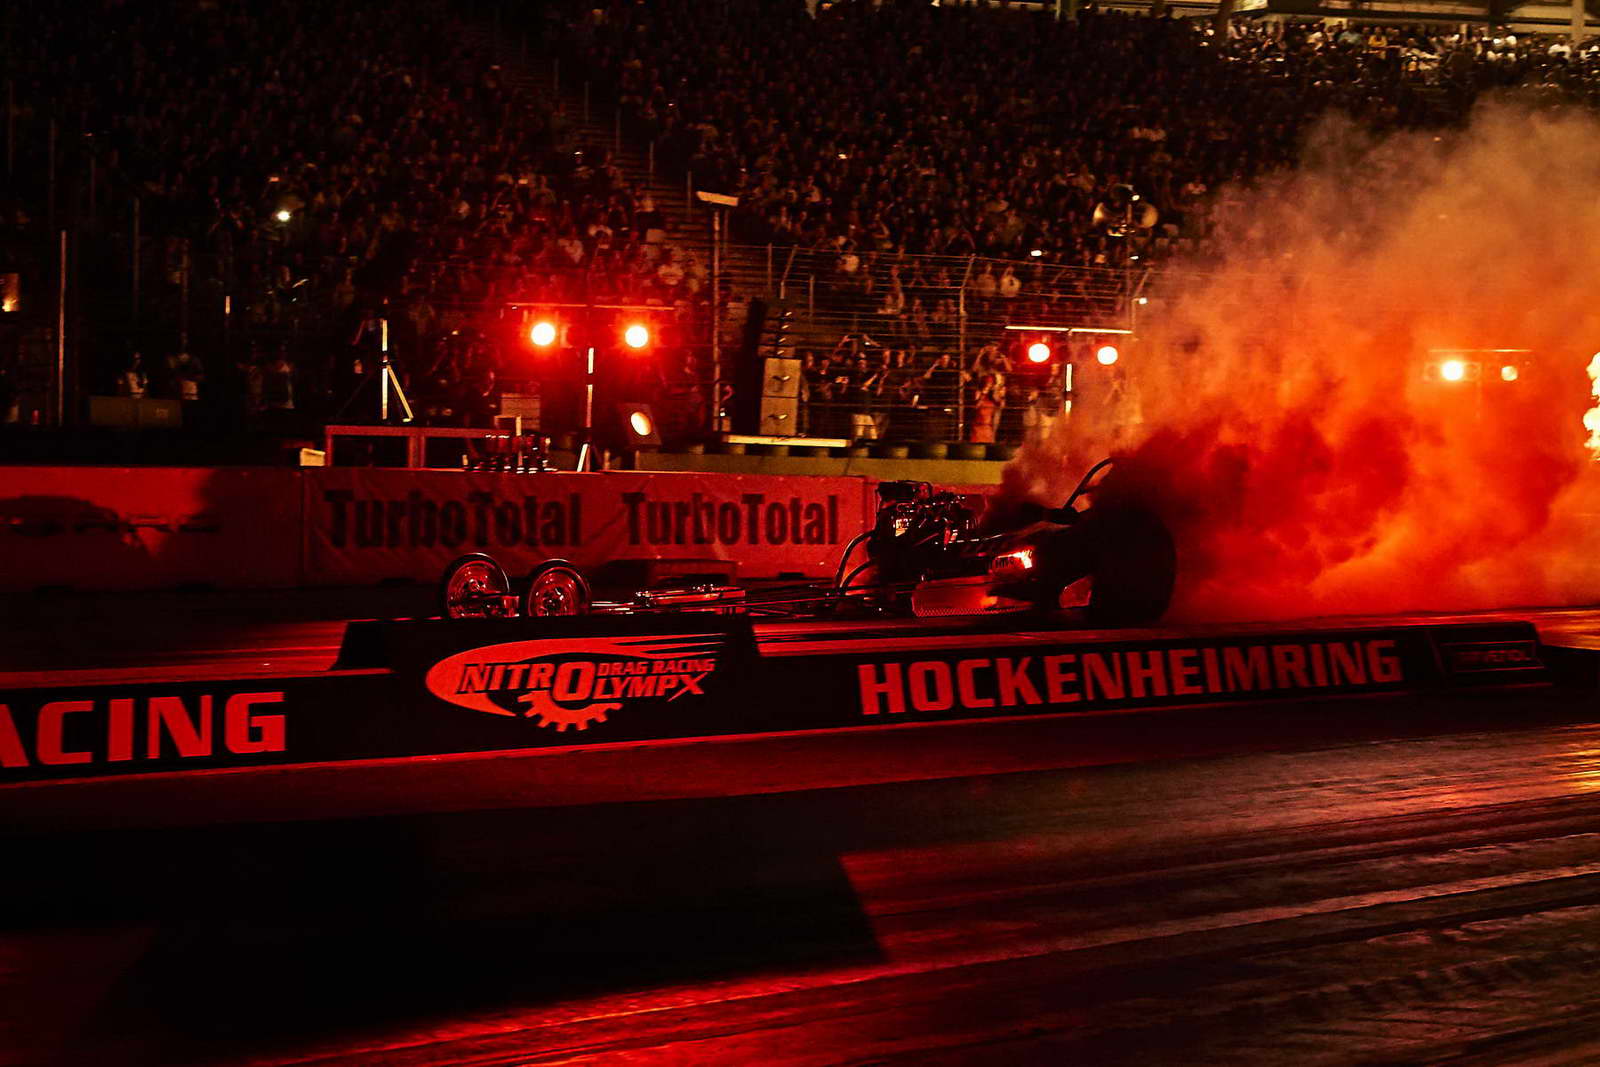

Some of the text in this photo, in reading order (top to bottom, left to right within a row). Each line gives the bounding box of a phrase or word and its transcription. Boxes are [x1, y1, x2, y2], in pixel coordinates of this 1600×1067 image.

[325, 489, 581, 548] TurboTotal
[622, 491, 838, 545] TurboTotal
[596, 657, 716, 676] DRAG RACING
[857, 639, 1402, 715] HOCKENHEIMRING
